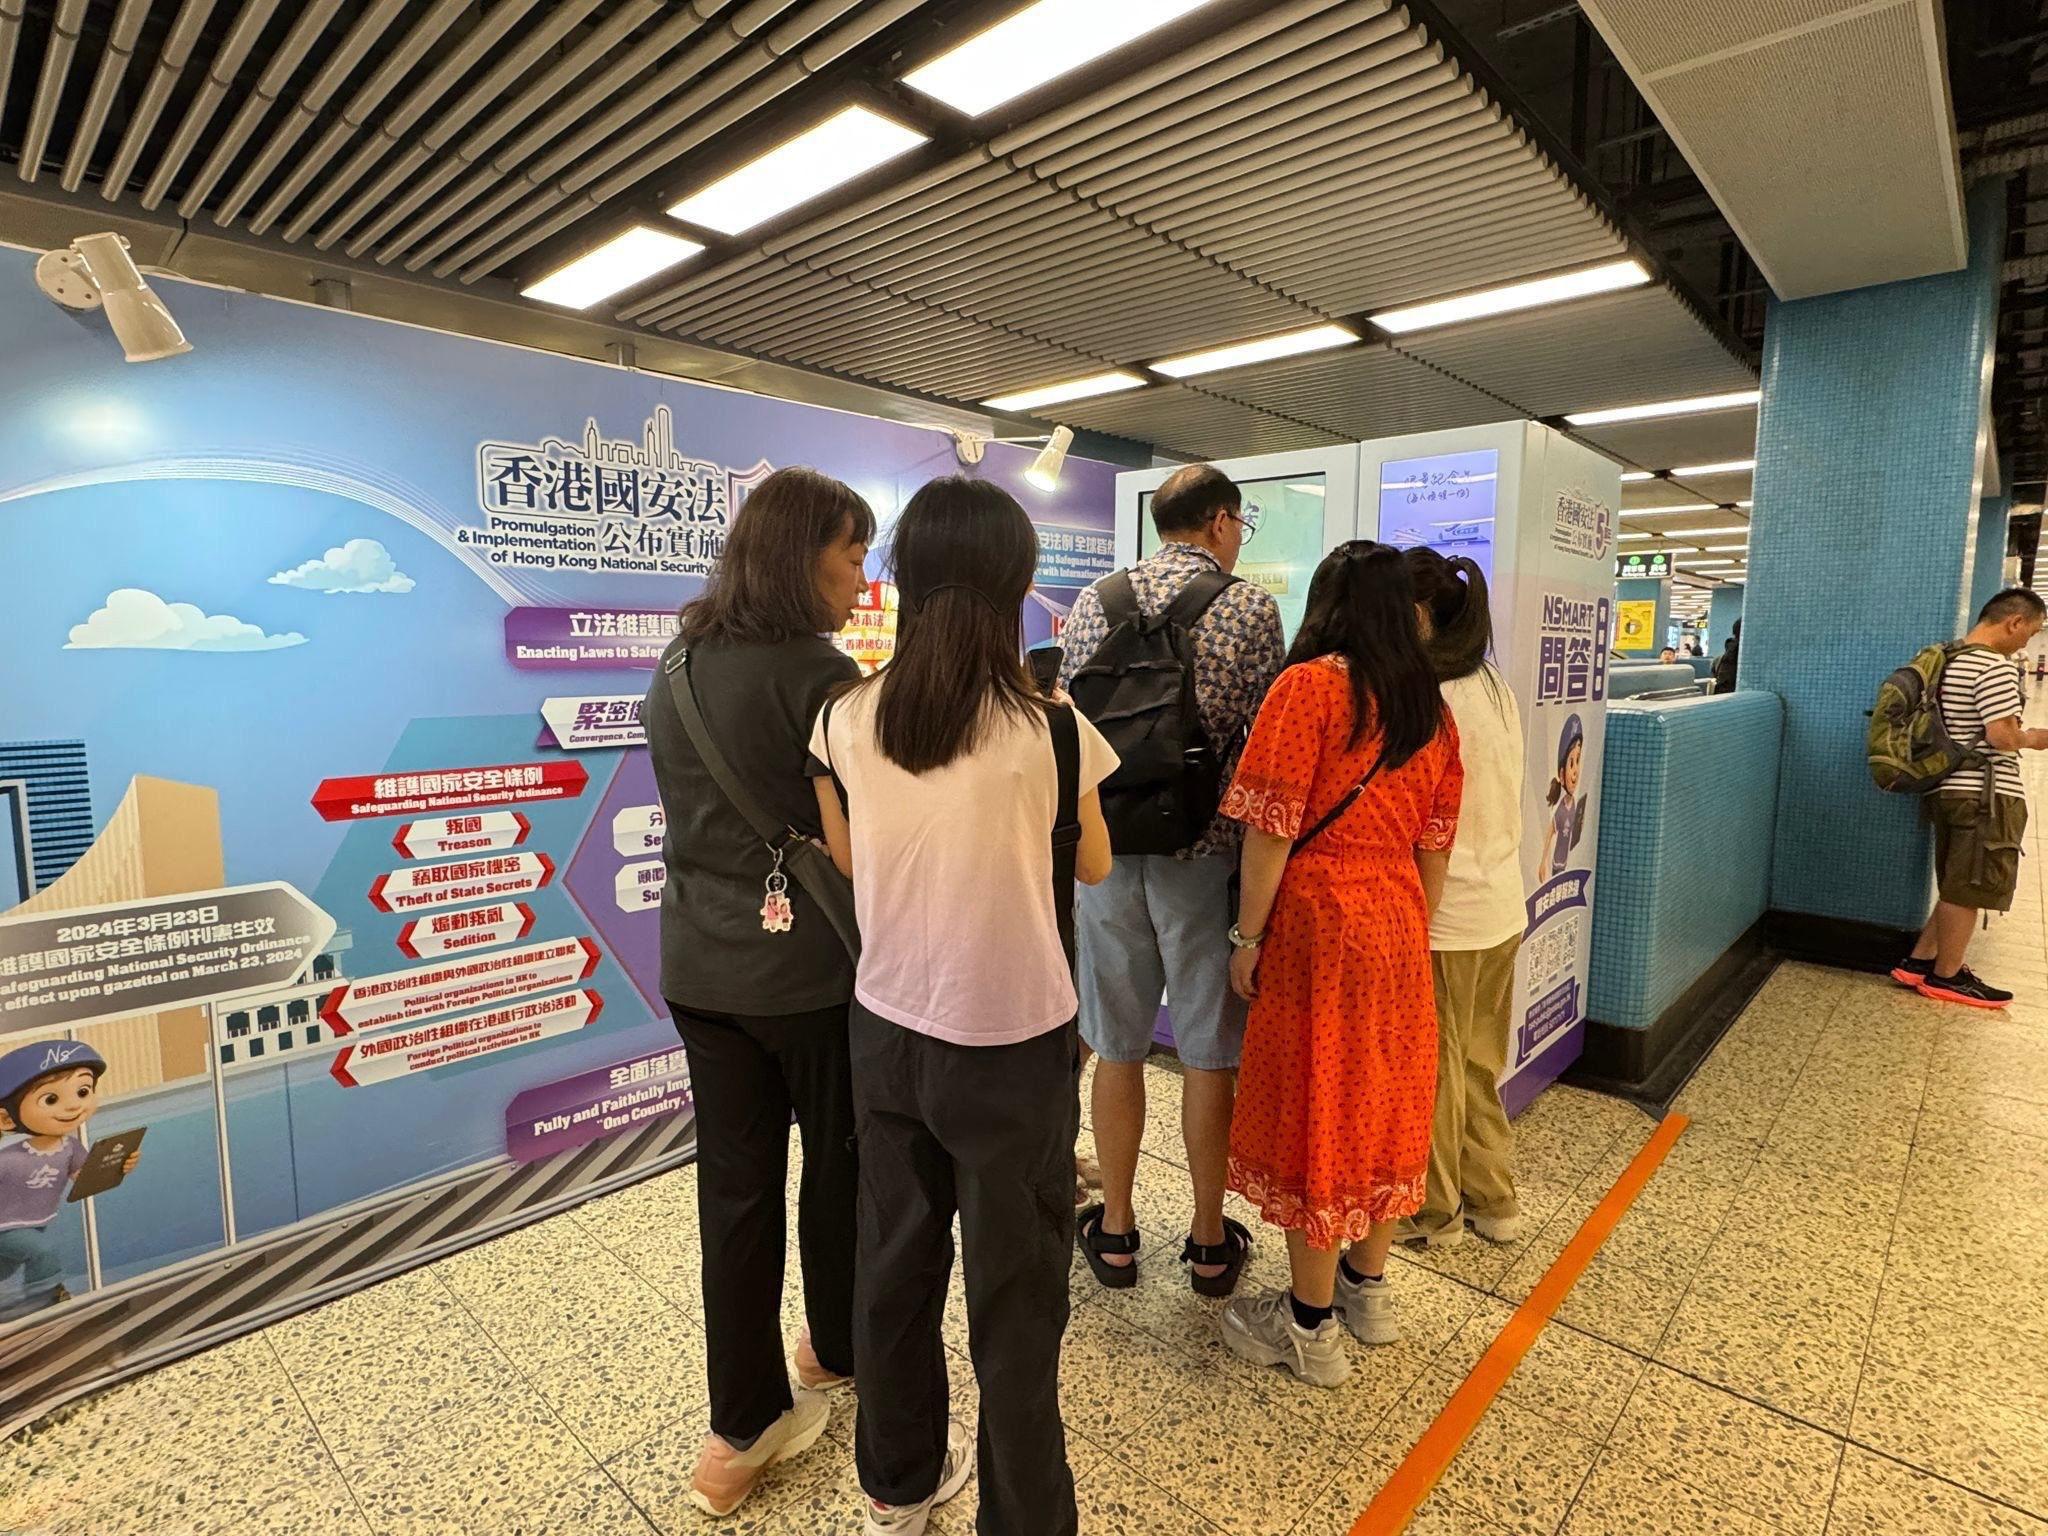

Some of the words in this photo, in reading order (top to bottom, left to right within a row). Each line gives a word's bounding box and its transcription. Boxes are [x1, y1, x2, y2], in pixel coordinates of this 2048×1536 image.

[490, 456, 725, 524] 香港國安法
[457, 530, 470, 543] &
[472, 532, 596, 552] Implementation
[491, 517, 595, 538] Promulgation
[602, 523, 724, 559] 公布實施
[491, 551, 508, 563] of
[513, 552, 555, 568] Hong
[559, 555, 597, 571] Kong
[600, 557, 658, 572] National
[660, 561, 712, 577] Security
[1055, 554, 1091, 567] Safeguard
[1543, 594, 1594, 628] NSMART
[516, 645, 578, 661] Enacting
[580, 645, 614, 659] Laws
[616, 647, 629, 659] to
[1537, 636, 1591, 702] 問答
[570, 732, 626, 743] Convergence,
[374, 766, 543, 799] 維護國家安全條例
[351, 797, 426, 815] Safeguarding
[429, 793, 472, 807] National
[473, 790, 515, 805] Security
[516, 786, 564, 799] Ordinance
[445, 816, 482, 836] 叛國
[438, 837, 492, 852] Treason
[412, 856, 521, 887] 竊取國家機密
[396, 893, 433, 908] Theft
[435, 890, 450, 902] of
[450, 885, 484, 900] State
[487, 878, 533, 893] Secrets
[57, 905, 220, 944] 2024年3月23日
[432, 906, 504, 935] 煽動叛亂
[107, 956, 174, 978] National
[177, 944, 238, 967] Security
[240, 934, 312, 955] Ordinance
[443, 931, 496, 950] Sedition
[4, 991, 57, 1012] effect
[58, 986, 101, 1004] upon
[103, 970, 168, 996] gazettal
[170, 968, 190, 981] on
[192, 961, 238, 978] March
[240, 955, 265, 970] 23,
[266, 947, 303, 964] 2024
[404, 993, 442, 1008] Political
[444, 980, 504, 1000] organizations
[505, 976, 514, 986] in
[515, 973, 528, 984] HK
[528, 971, 538, 981] to
[357, 1012, 404, 1029] establish
[405, 1007, 423, 1019] ties
[424, 1002, 446, 1015] with
[446, 995, 481, 1012] Foreign
[481, 986, 518, 1002] Political
[518, 973, 574, 994] organizations
[407, 1047, 442, 1063] Foreign
[442, 1038, 478, 1055] Political
[478, 1025, 533, 1045] organizations
[533, 1022, 542, 1031] to
[409, 1055, 445, 1070] conduct
[445, 1046, 481, 1063] political
[482, 1035, 519, 1052] activities
[519, 1033, 528, 1042] in
[528, 1030, 542, 1039] HK
[534, 1114, 571, 1137] Fully
[573, 1103, 600, 1123] and
[601, 1084, 666, 1114] Faithfully
